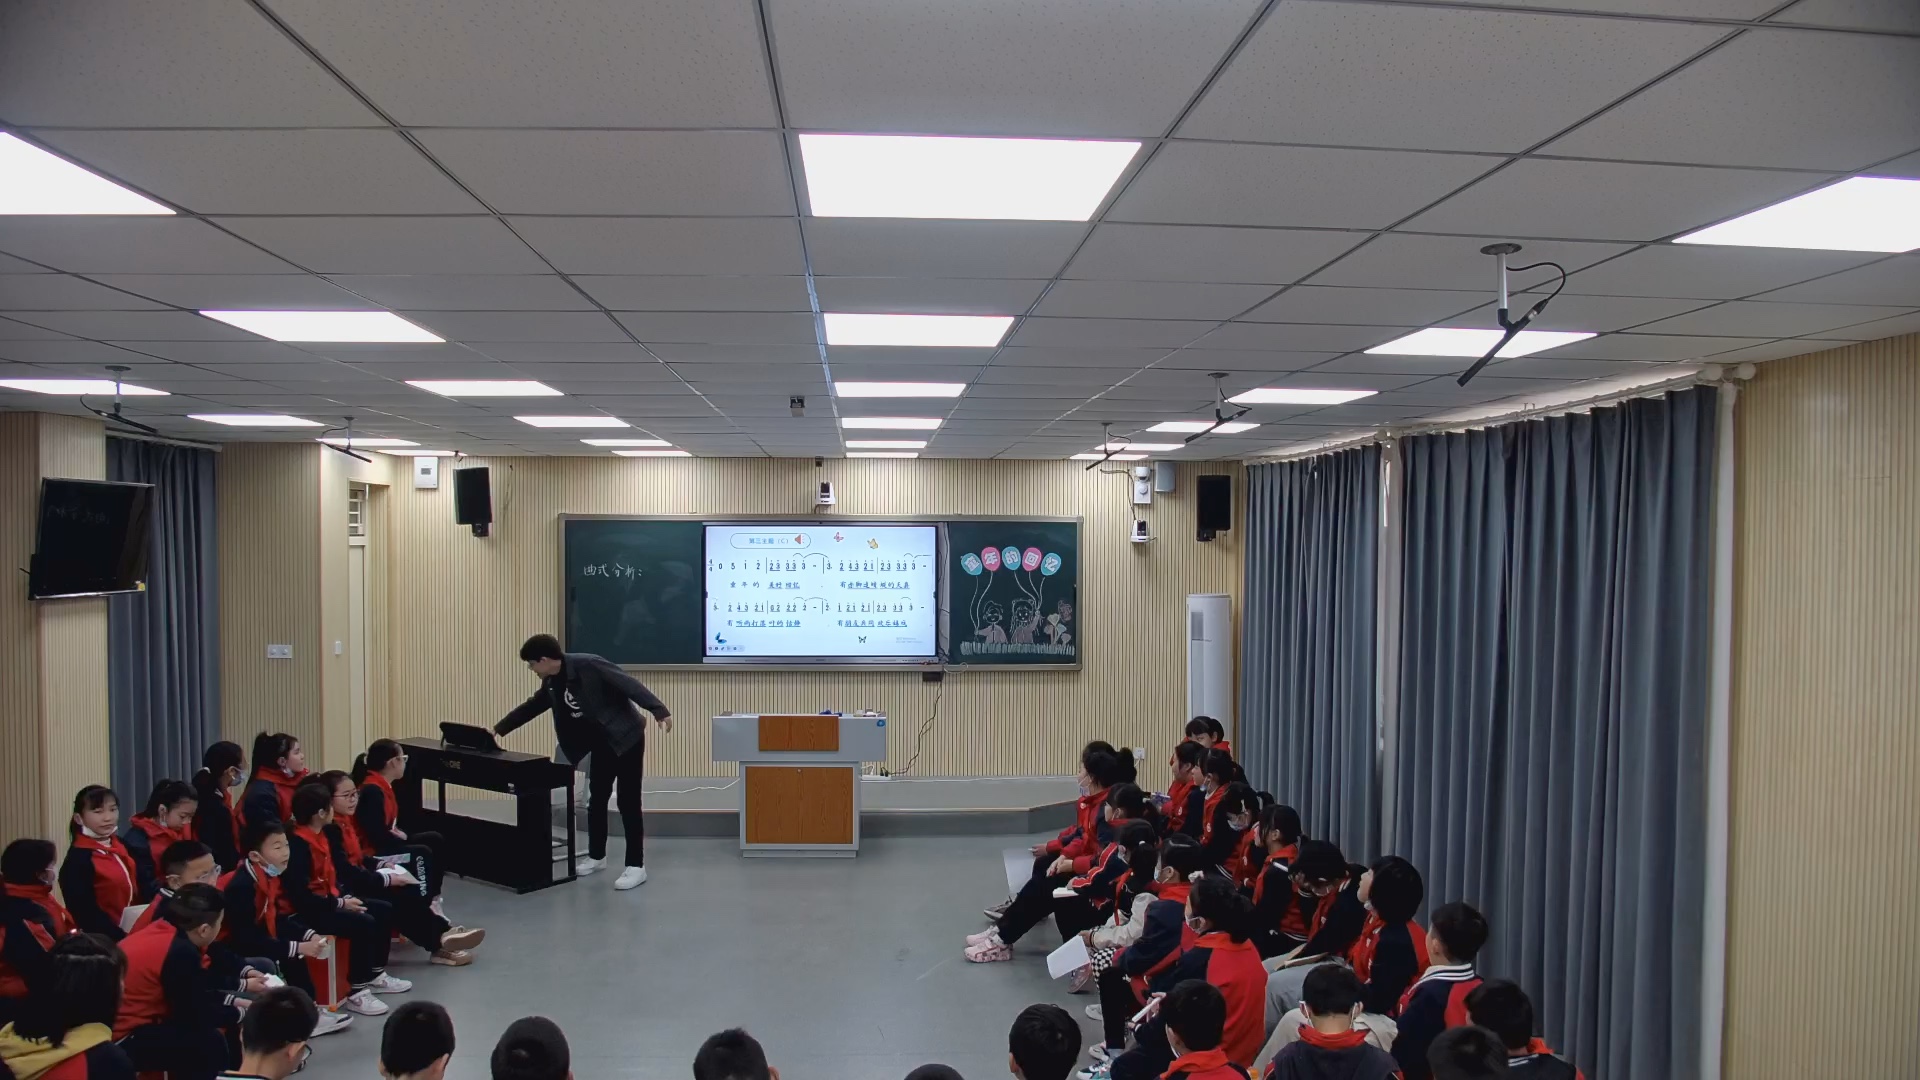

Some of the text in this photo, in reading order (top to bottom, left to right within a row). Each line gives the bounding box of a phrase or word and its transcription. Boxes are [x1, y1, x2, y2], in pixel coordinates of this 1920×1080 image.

[964, 550, 1059, 572] 童年的回忆
